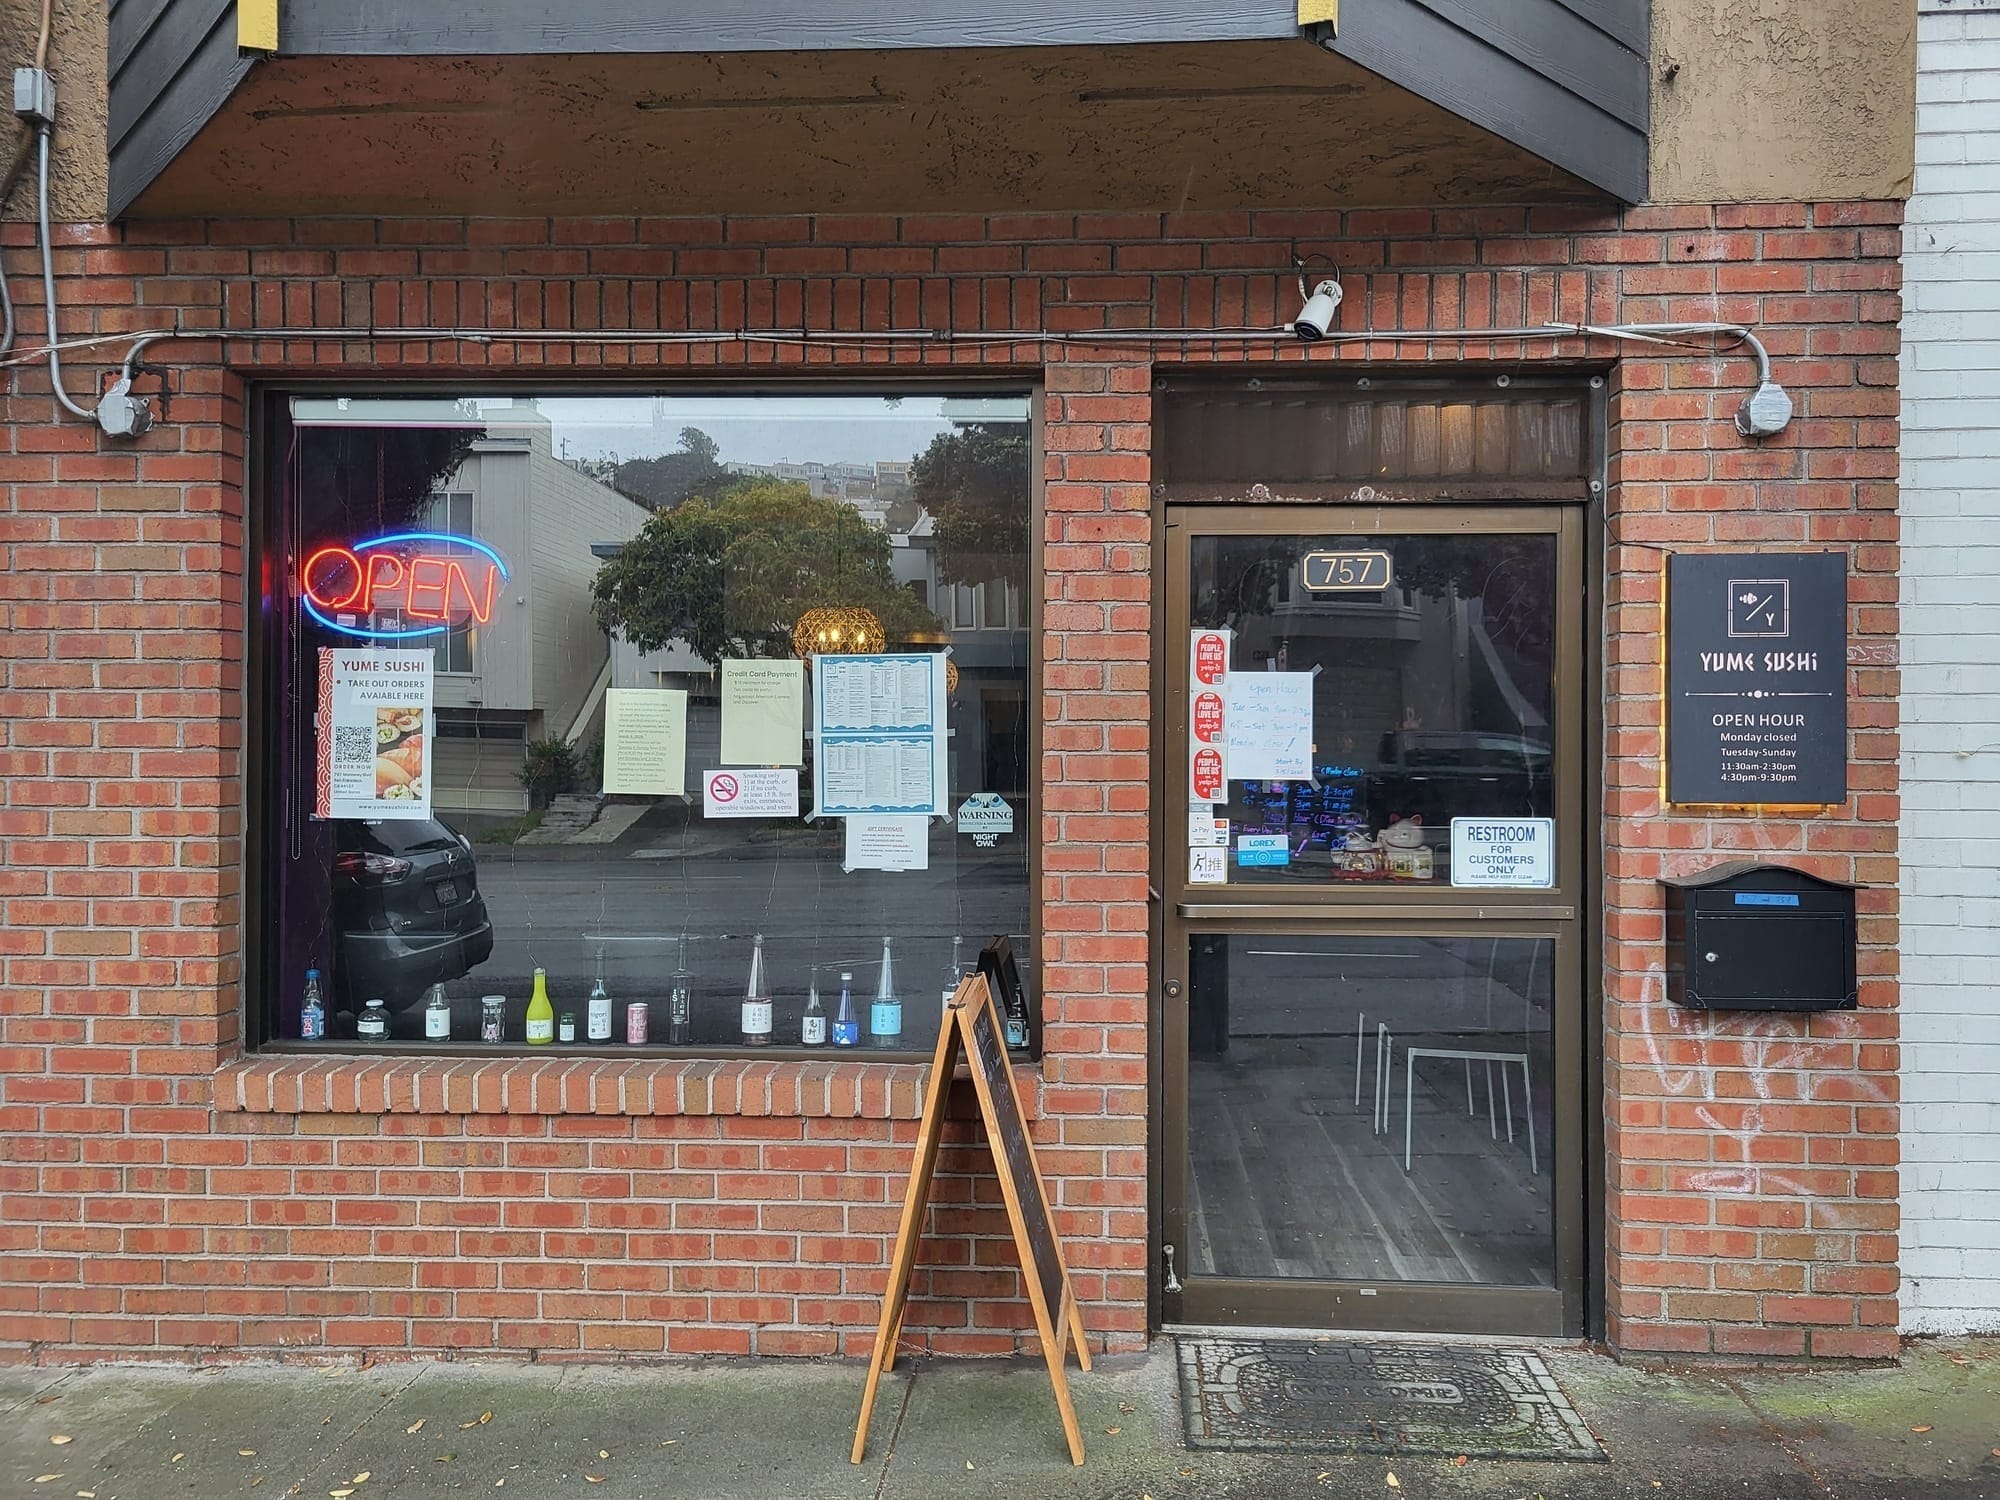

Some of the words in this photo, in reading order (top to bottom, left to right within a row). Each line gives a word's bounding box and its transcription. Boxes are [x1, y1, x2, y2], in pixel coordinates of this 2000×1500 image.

[1320, 558, 1373, 584] 757
[304, 548, 497, 623] OPEN
[1765, 612, 1775, 626] Y
[1200, 644, 1221, 652] PEOPLE
[1200, 652, 1213, 660] LOVE
[342, 660, 379, 672] YUME
[384, 661, 425, 672] SUSHI
[1700, 652, 1755, 672] YUME
[767, 670, 798, 678] Payment
[348, 680, 370, 688] TAKE
[371, 680, 389, 688] OUT
[391, 680, 425, 688] ORDERS
[360, 692, 401, 700] AVAIABLE
[403, 692, 425, 700] HERE
[1198, 702, 1219, 710] PEOPLE
[1712, 714, 1755, 726] OPEN
[1759, 714, 1805, 726] HOUR
[1720, 732, 1762, 743] Monday
[1763, 732, 1797, 742] closed
[1721, 748, 1797, 758] Tuesday-Sunday
[1197, 758, 1218, 766] PEOPLE
[1721, 762, 1797, 771] 11:30am-2:30pm
[1197, 767, 1210, 775] LOVE
[1720, 773, 1797, 783] 4:30pm-9:30pm
[959, 811, 1013, 820] WARNING
[1468, 826, 1535, 841] RESTROOM
[1490, 845, 1512, 854] FOR
[1469, 855, 1534, 864] CUSTOMERS
[1208, 857, 1223, 872] 推
[1487, 865, 1516, 874] ONLY
